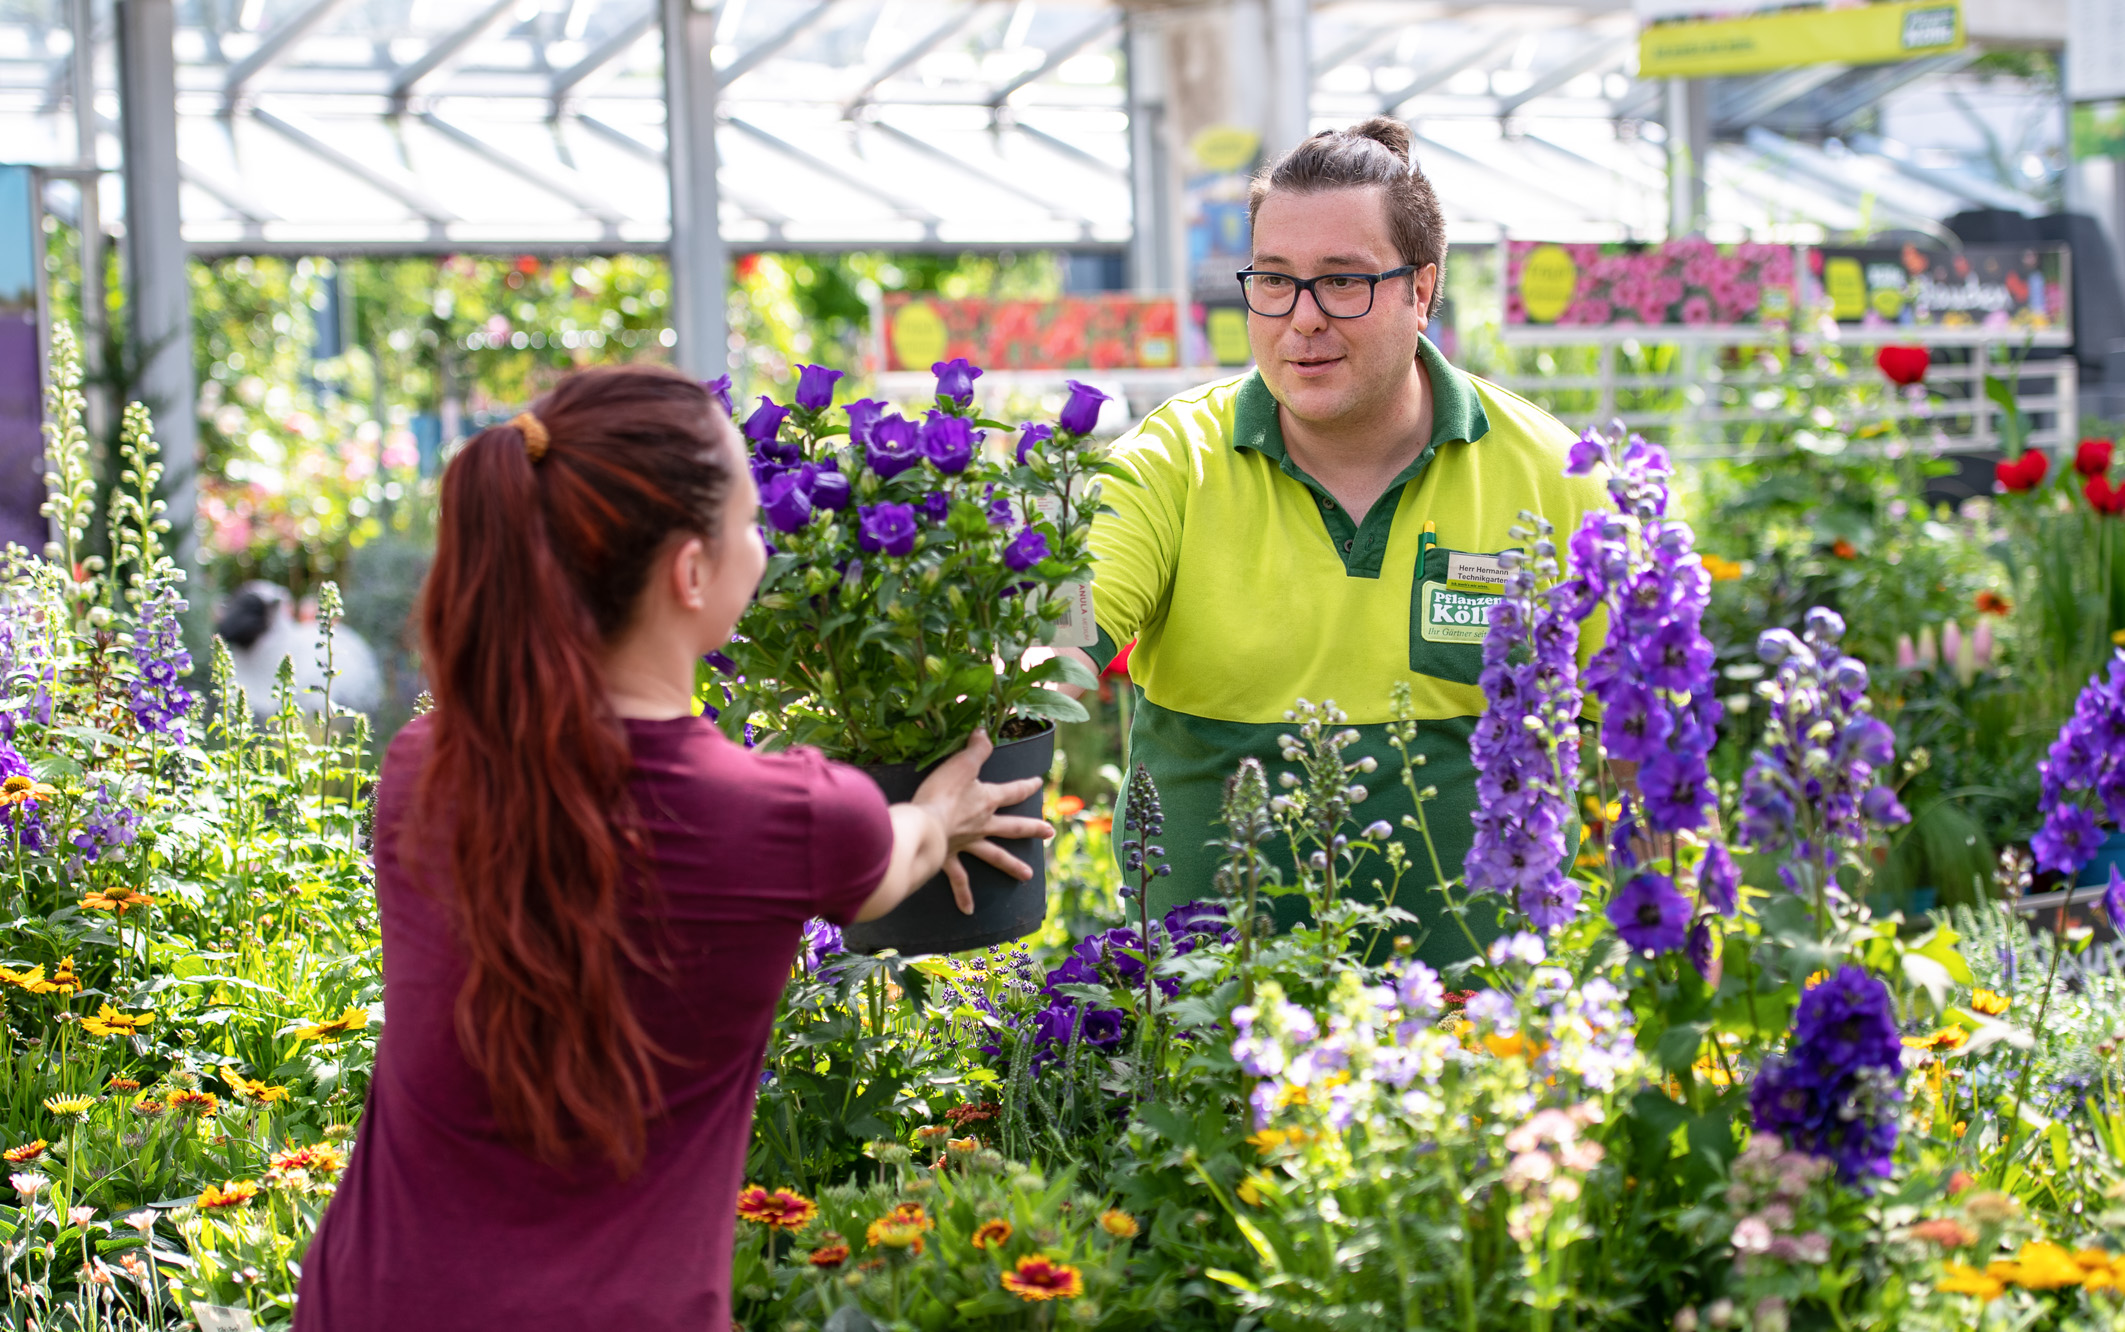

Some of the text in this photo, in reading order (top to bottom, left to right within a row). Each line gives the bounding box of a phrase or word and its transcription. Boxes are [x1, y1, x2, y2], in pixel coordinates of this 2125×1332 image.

[1476, 567, 1508, 575] Hermann
[1434, 592, 1502, 605] Pflanzen
[1432, 603, 1490, 624] Köll
[1428, 627, 1440, 635] Ihr
[1442, 627, 1472, 637] Gärtner
